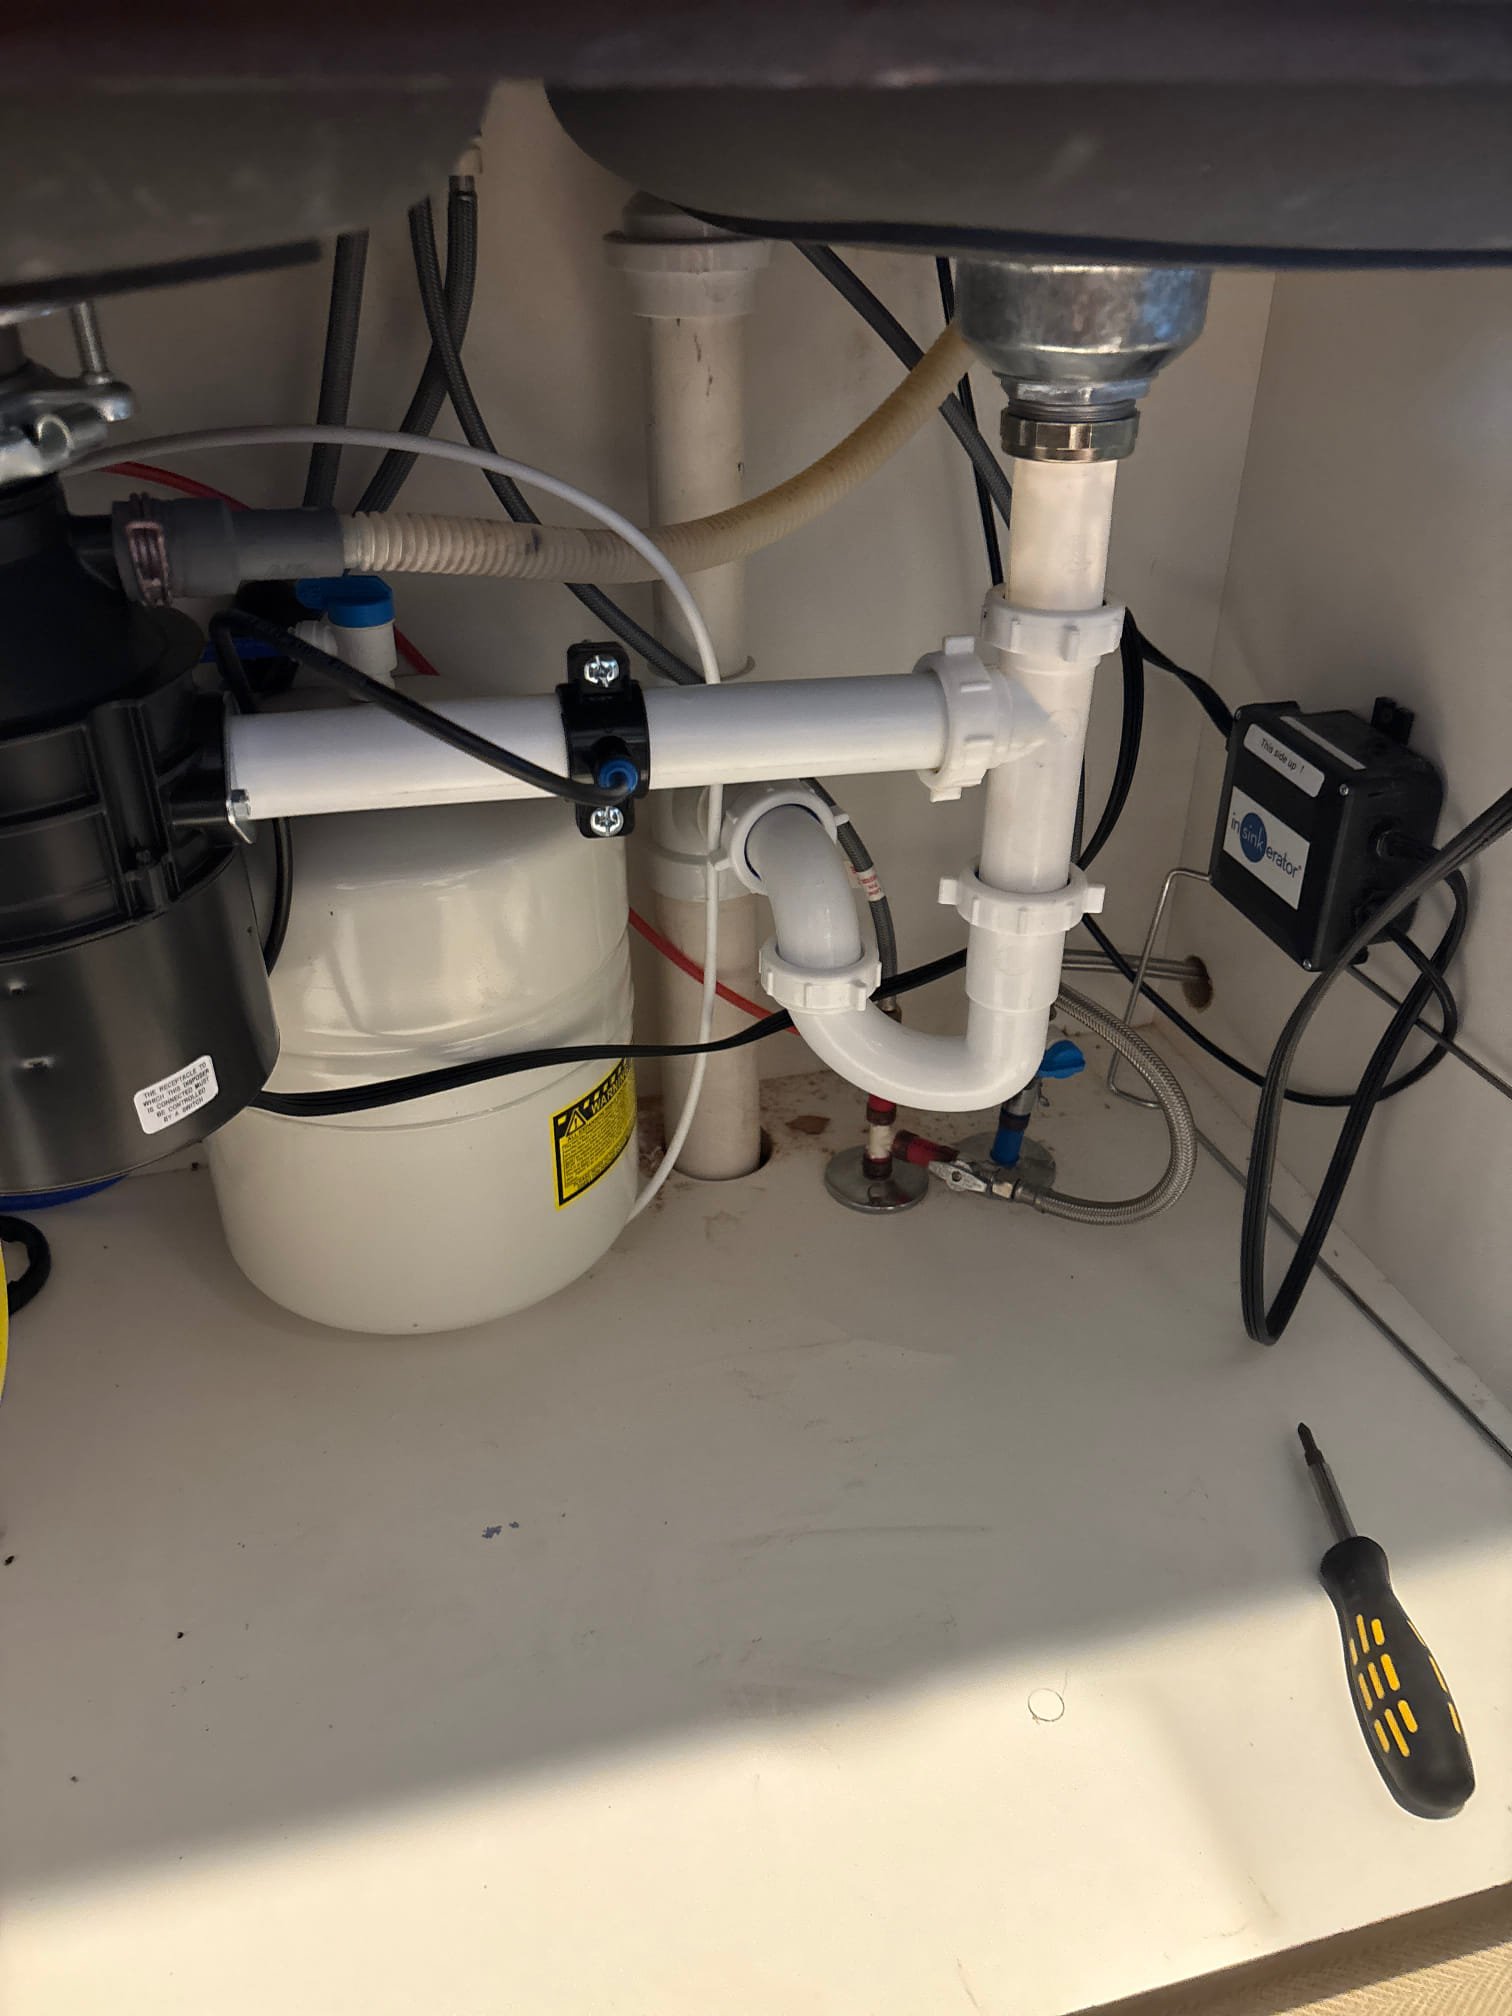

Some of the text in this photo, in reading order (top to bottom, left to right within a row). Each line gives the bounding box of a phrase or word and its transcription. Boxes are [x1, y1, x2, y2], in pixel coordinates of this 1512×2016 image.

[1261, 738, 1274, 753] This
[1273, 750, 1288, 763] side
[1287, 760, 1297, 770] up
[144, 1089, 157, 1099] THE
[199, 1062, 207, 1071] TO
[156, 1087, 193, 1110] CONNECTED
